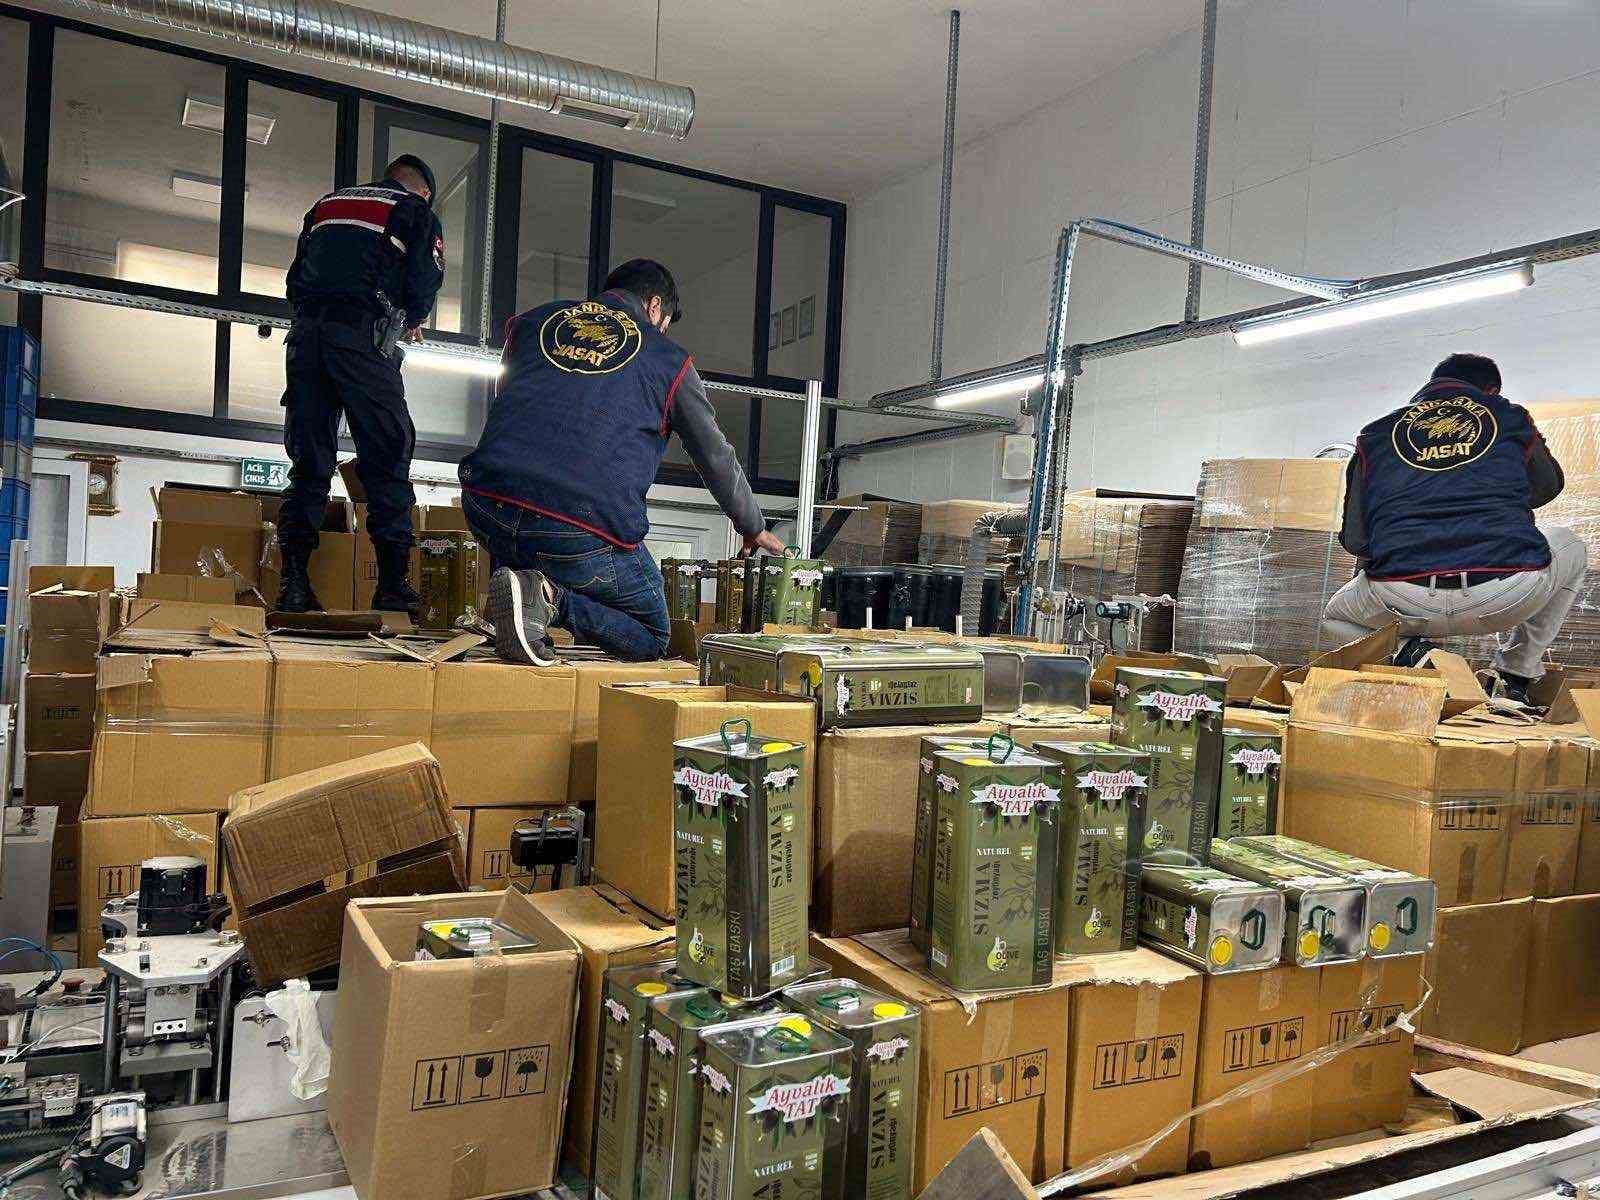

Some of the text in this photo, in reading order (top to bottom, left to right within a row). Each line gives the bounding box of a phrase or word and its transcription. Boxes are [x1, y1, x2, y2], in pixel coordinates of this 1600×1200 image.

[553, 345, 608, 367] JASAT
[1403, 399, 1487, 424] JANDARMA
[1416, 442, 1473, 462] JASAT
[868, 692, 919, 706] SIZMA
[1152, 693, 1209, 709] Ayvalık
[1168, 706, 1194, 719] TAT
[683, 769, 734, 791] Ayvalık
[1089, 772, 1136, 788] Ayvalık
[697, 788, 718, 802] TAT
[986, 784, 1047, 802] Ayvalık
[1101, 785, 1123, 798] TAT
[1004, 800, 1030, 813] TAT
[770, 815, 785, 888] SIZMA
[976, 847, 1011, 857] NATUREL
[1073, 842, 1092, 906] SIZMA
[974, 862, 992, 936] SIZMA
[996, 950, 1020, 960] OLIVE
[768, 1077, 836, 1107] Ayvalık
[786, 1098, 818, 1119] TAT
[871, 1090, 887, 1170] SIZMA
[753, 1160, 794, 1178] NATUREL
